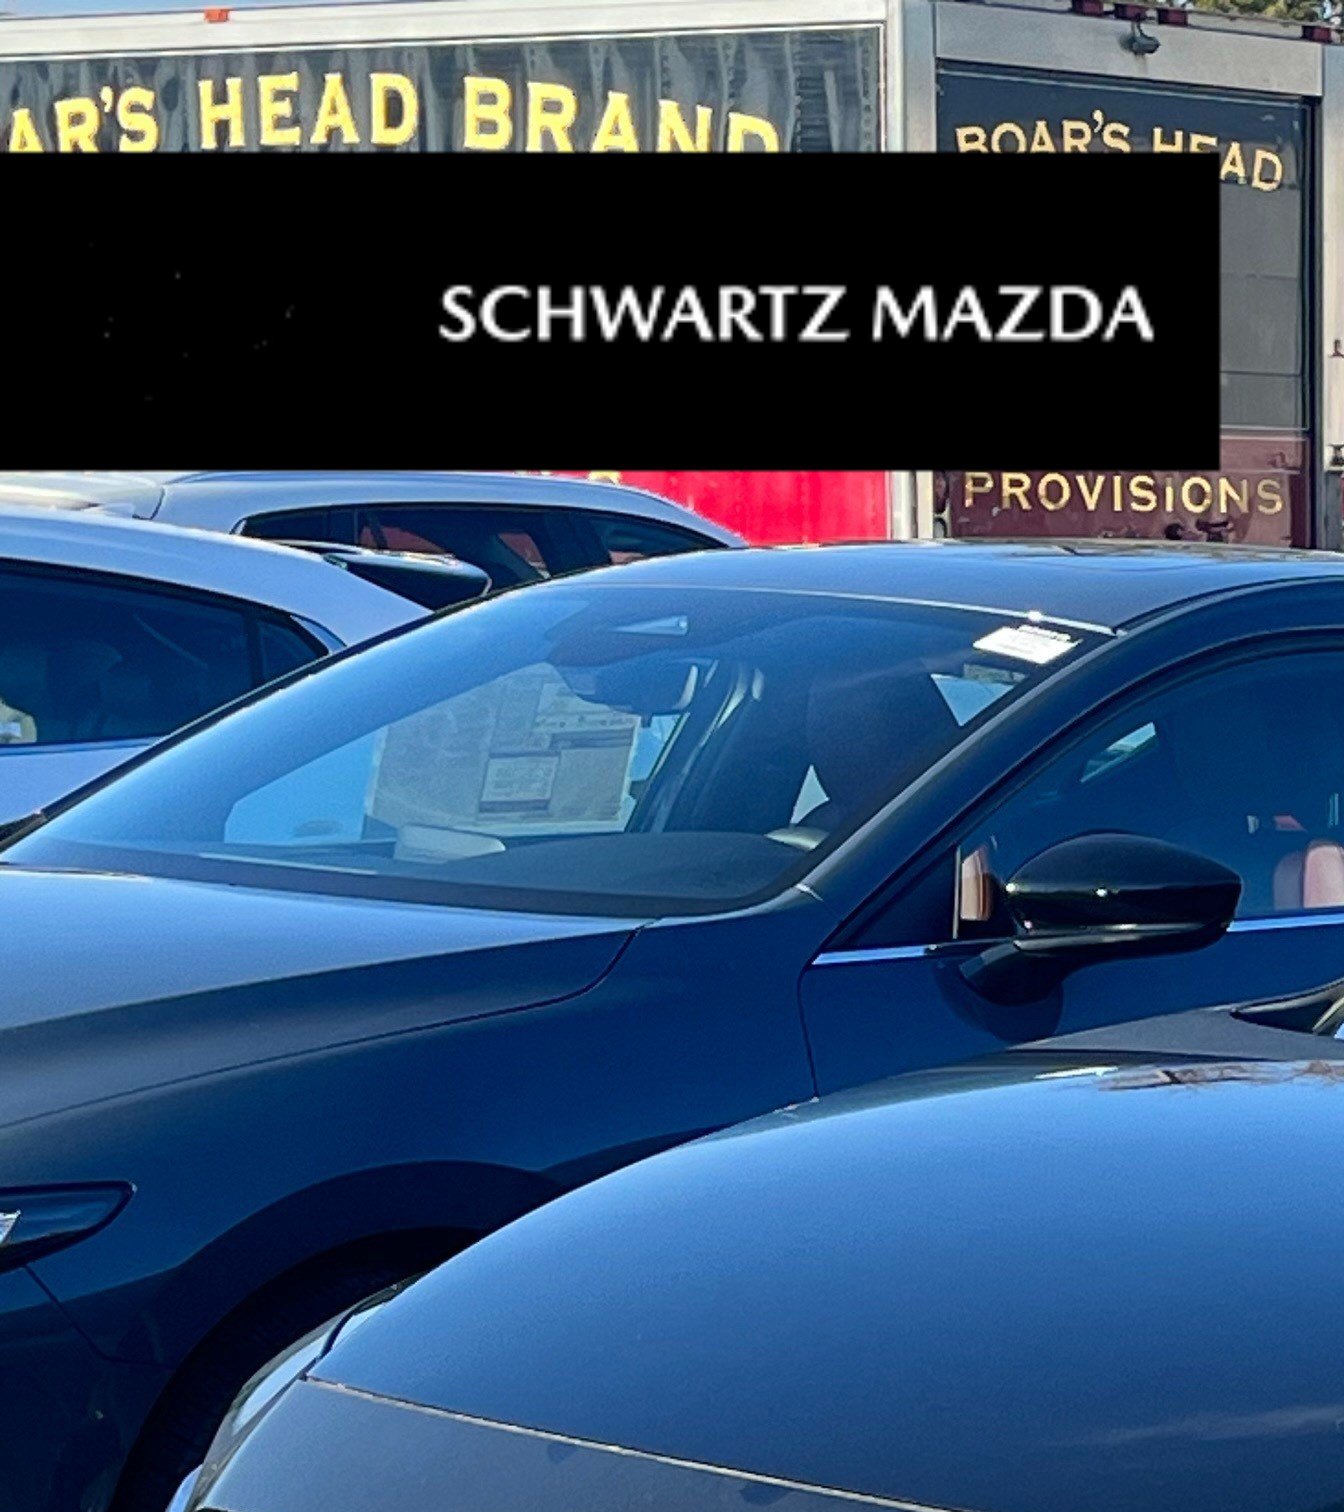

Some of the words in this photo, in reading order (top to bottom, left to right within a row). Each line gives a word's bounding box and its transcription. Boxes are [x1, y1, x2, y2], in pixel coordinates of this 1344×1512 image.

[198, 72, 419, 149] HEAD
[463, 76, 780, 152] BRAND
[955, 110, 1133, 152] BOAR'S
[963, 471, 1284, 515] PROVISIONS
